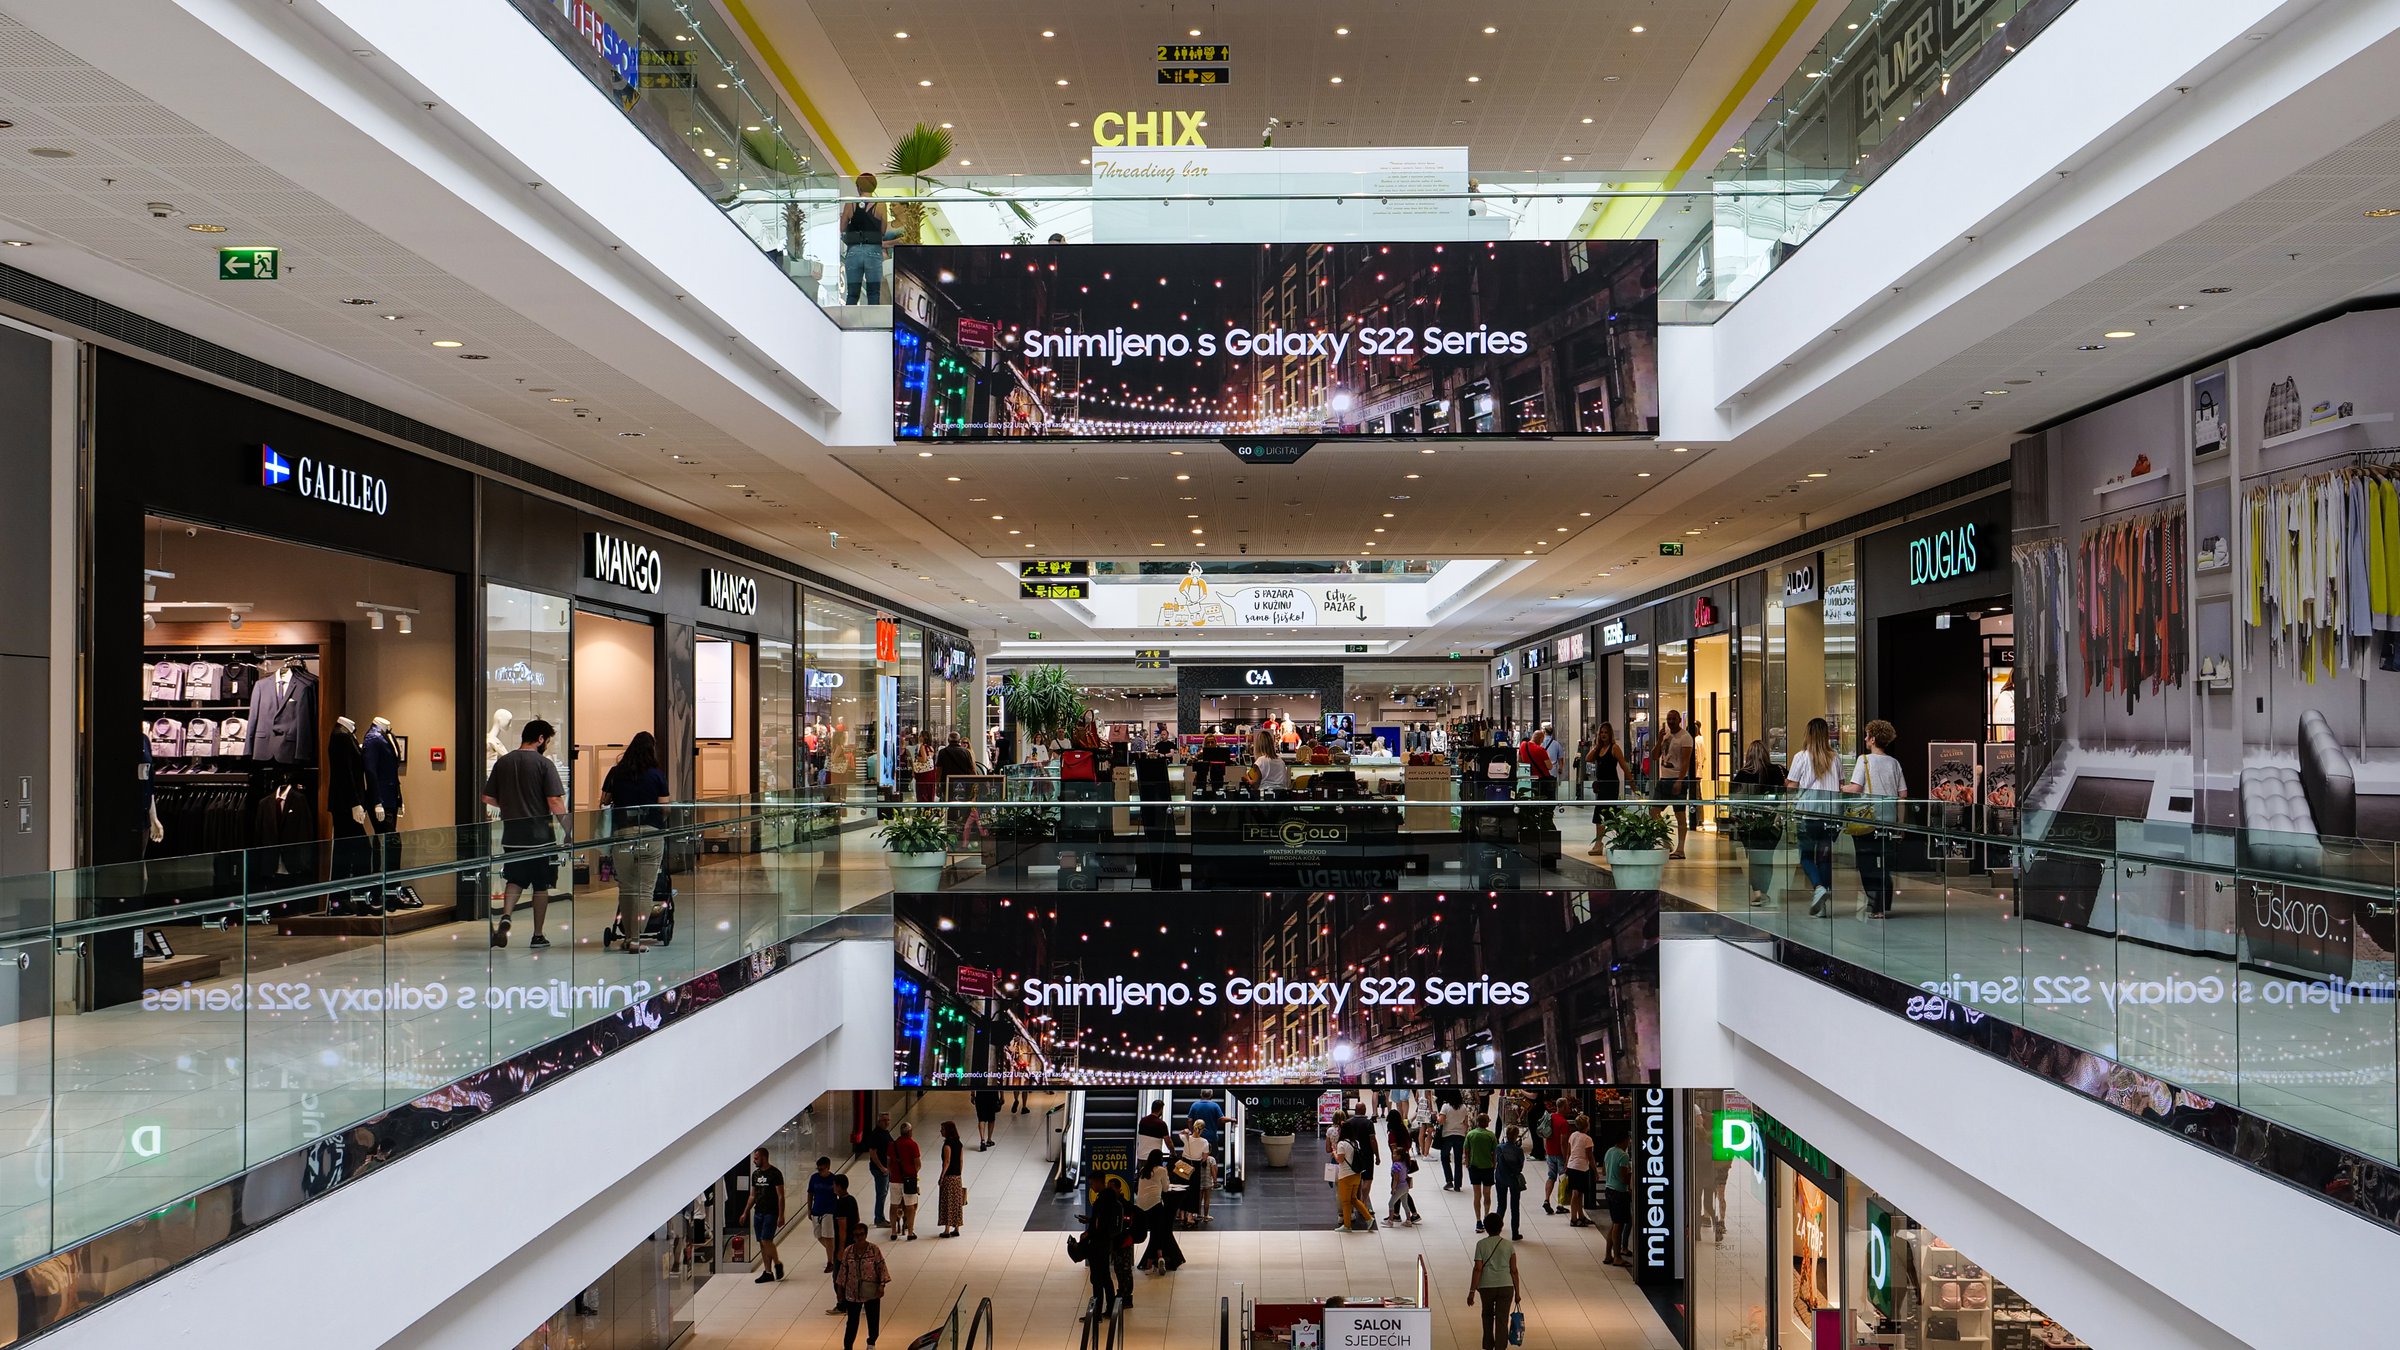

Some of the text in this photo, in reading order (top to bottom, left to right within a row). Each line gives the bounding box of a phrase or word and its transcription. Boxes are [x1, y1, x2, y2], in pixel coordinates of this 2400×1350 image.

[1157, 46, 1168, 61] 2
[1093, 110, 1207, 147] CHIX
[1094, 160, 1209, 183] Threading bar
[1023, 325, 1528, 366] Snimljeno s Galaxy S22 Series
[1239, 446, 1299, 456] GO DIGITAL
[298, 456, 387, 515] GALILEO
[1910, 522, 1976, 586] DOUGLAS
[595, 531, 661, 595] MANGO
[1786, 566, 1811, 596] ALDO
[710, 568, 758, 616] MANGO
[1254, 589, 1295, 599] S PAZARA
[1326, 588, 1347, 602] City
[1254, 599, 1292, 610] U KUŽINU
[1324, 601, 1355, 612] PAZAR
[1245, 610, 1305, 625] samo friško!
[1245, 669, 1273, 685] C&A
[1022, 976, 1530, 1015] Snimljeno s Galaxy S22 Series
[1245, 1096, 1306, 1106] GO DIGITAL
[1722, 1119, 1752, 1151] D
[1091, 1160, 1128, 1171] NOVI!
[1870, 1222, 1887, 1290] D
[1354, 1319, 1402, 1331] SALON
[1345, 1332, 1411, 1347] SJEDEĆIH
